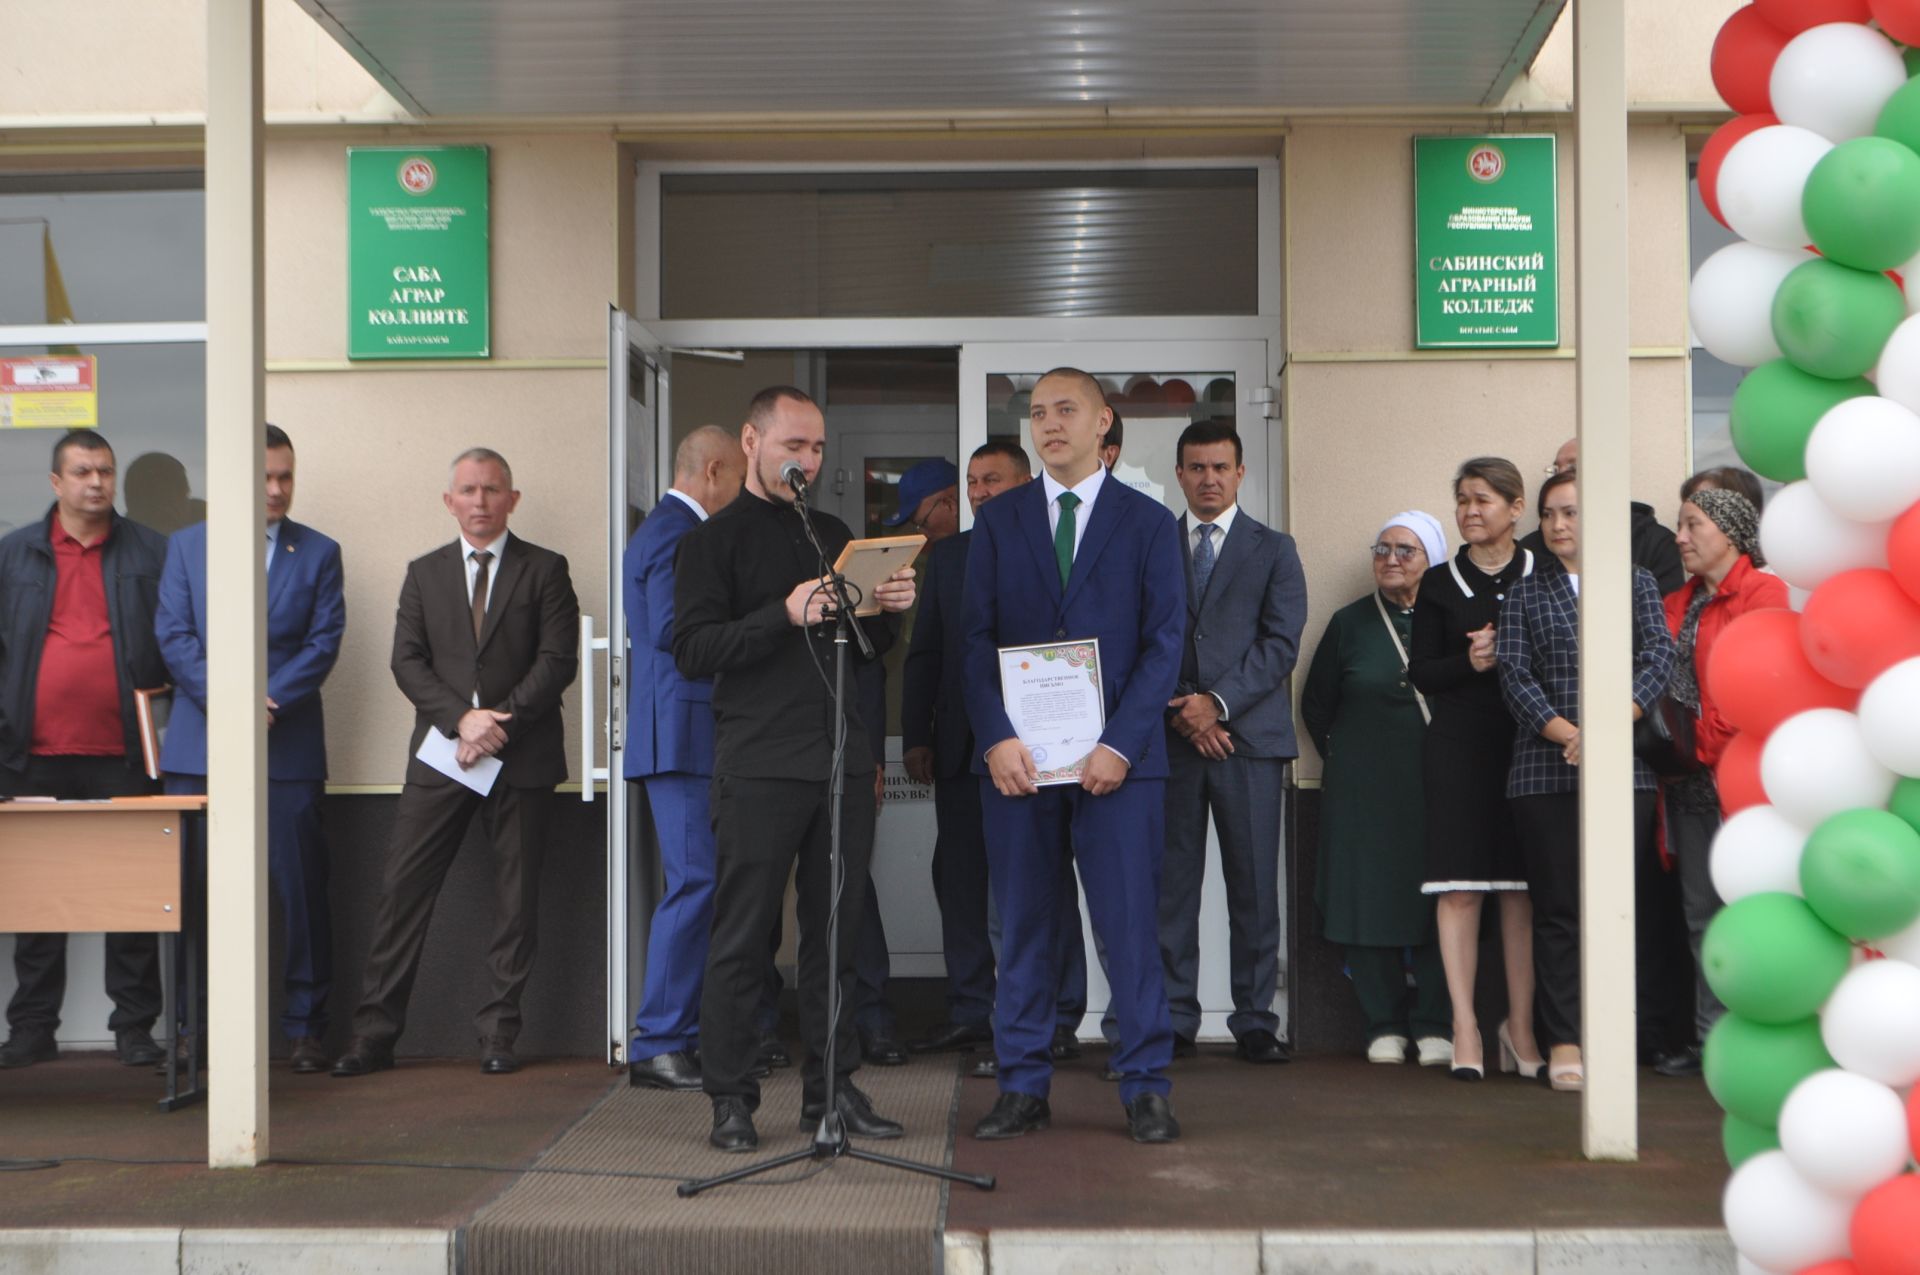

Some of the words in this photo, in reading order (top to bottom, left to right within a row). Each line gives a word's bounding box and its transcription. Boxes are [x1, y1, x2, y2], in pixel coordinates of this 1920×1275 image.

[1429, 252, 1544, 271] САБИНСКИЙ
[393, 266, 442, 282] САБА
[1438, 274, 1536, 292] АГРАРНЫЙ
[390, 288, 445, 303] АГРАР
[1443, 299, 1533, 316] КОЛЛЕДЖ
[883, 790, 930, 799] ОБУВЬ!
